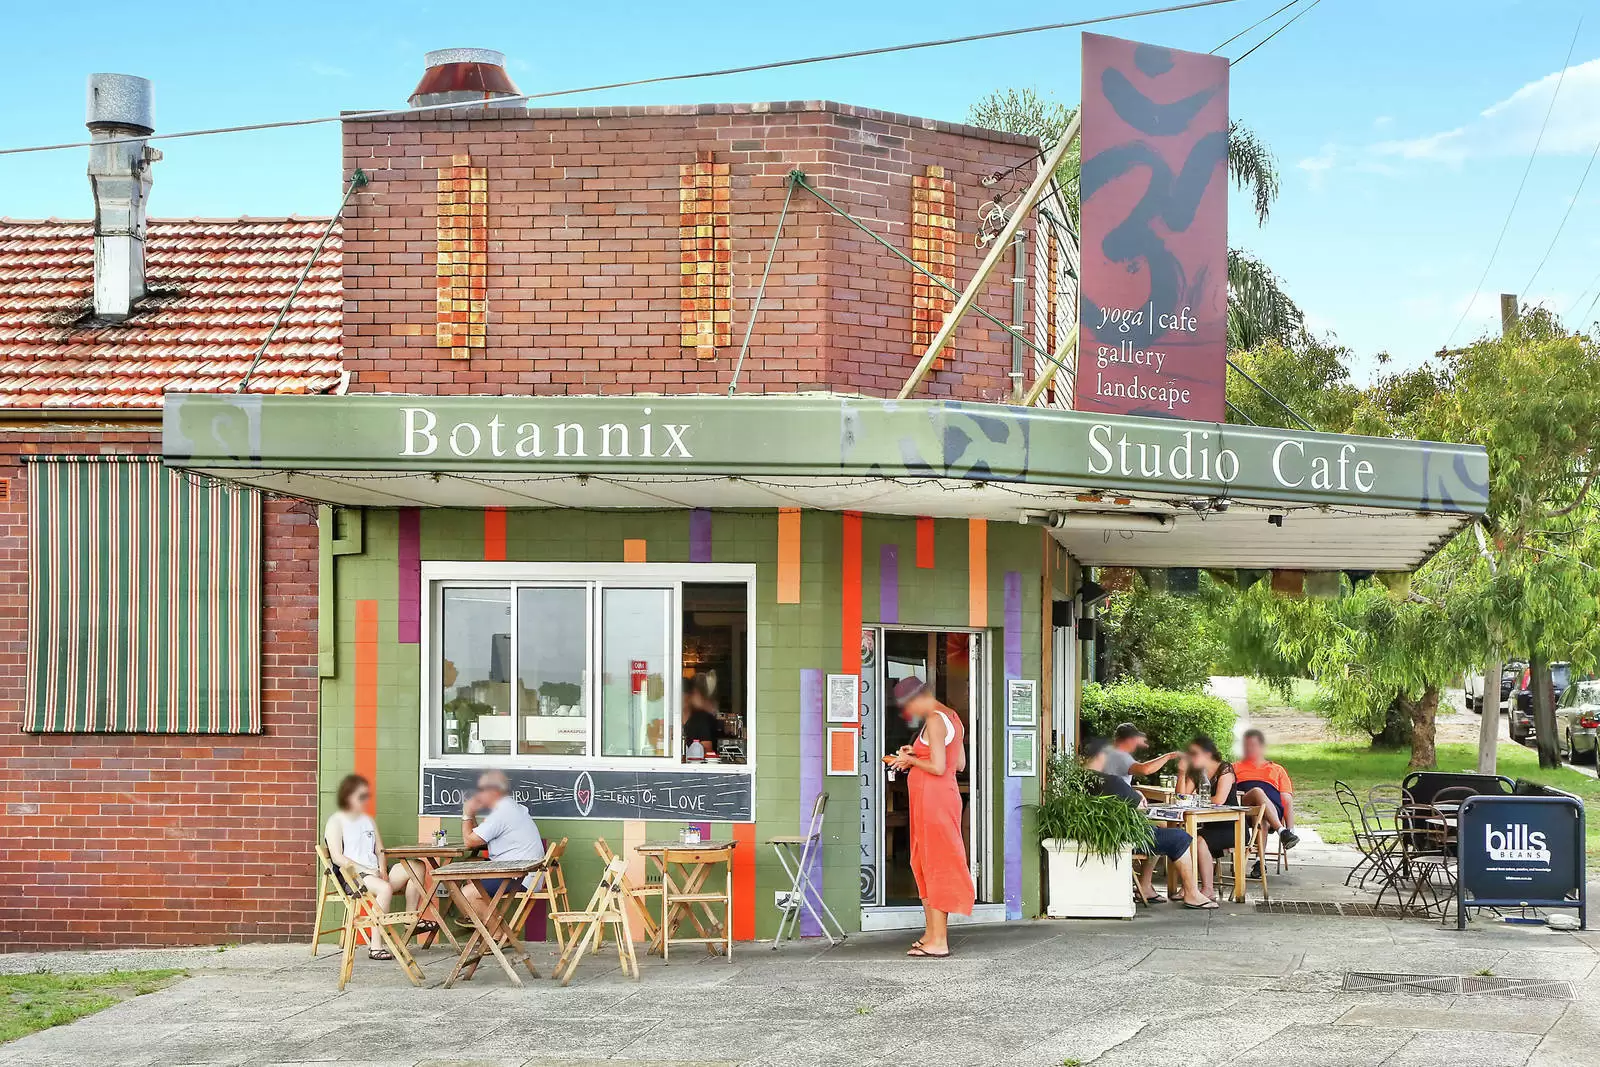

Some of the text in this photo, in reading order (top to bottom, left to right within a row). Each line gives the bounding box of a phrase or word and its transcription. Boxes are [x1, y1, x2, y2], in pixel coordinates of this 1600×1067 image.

[1096, 306, 1198, 333] yoga cafe
[1096, 339, 1166, 374] gallery
[1096, 372, 1191, 410] landscape
[398, 407, 694, 458] Botannix
[1088, 424, 1376, 493] Studio Cafe
[668, 788, 705, 811] LOVE
[1485, 823, 1547, 851] bills
[1500, 851, 1541, 859] BEANS
